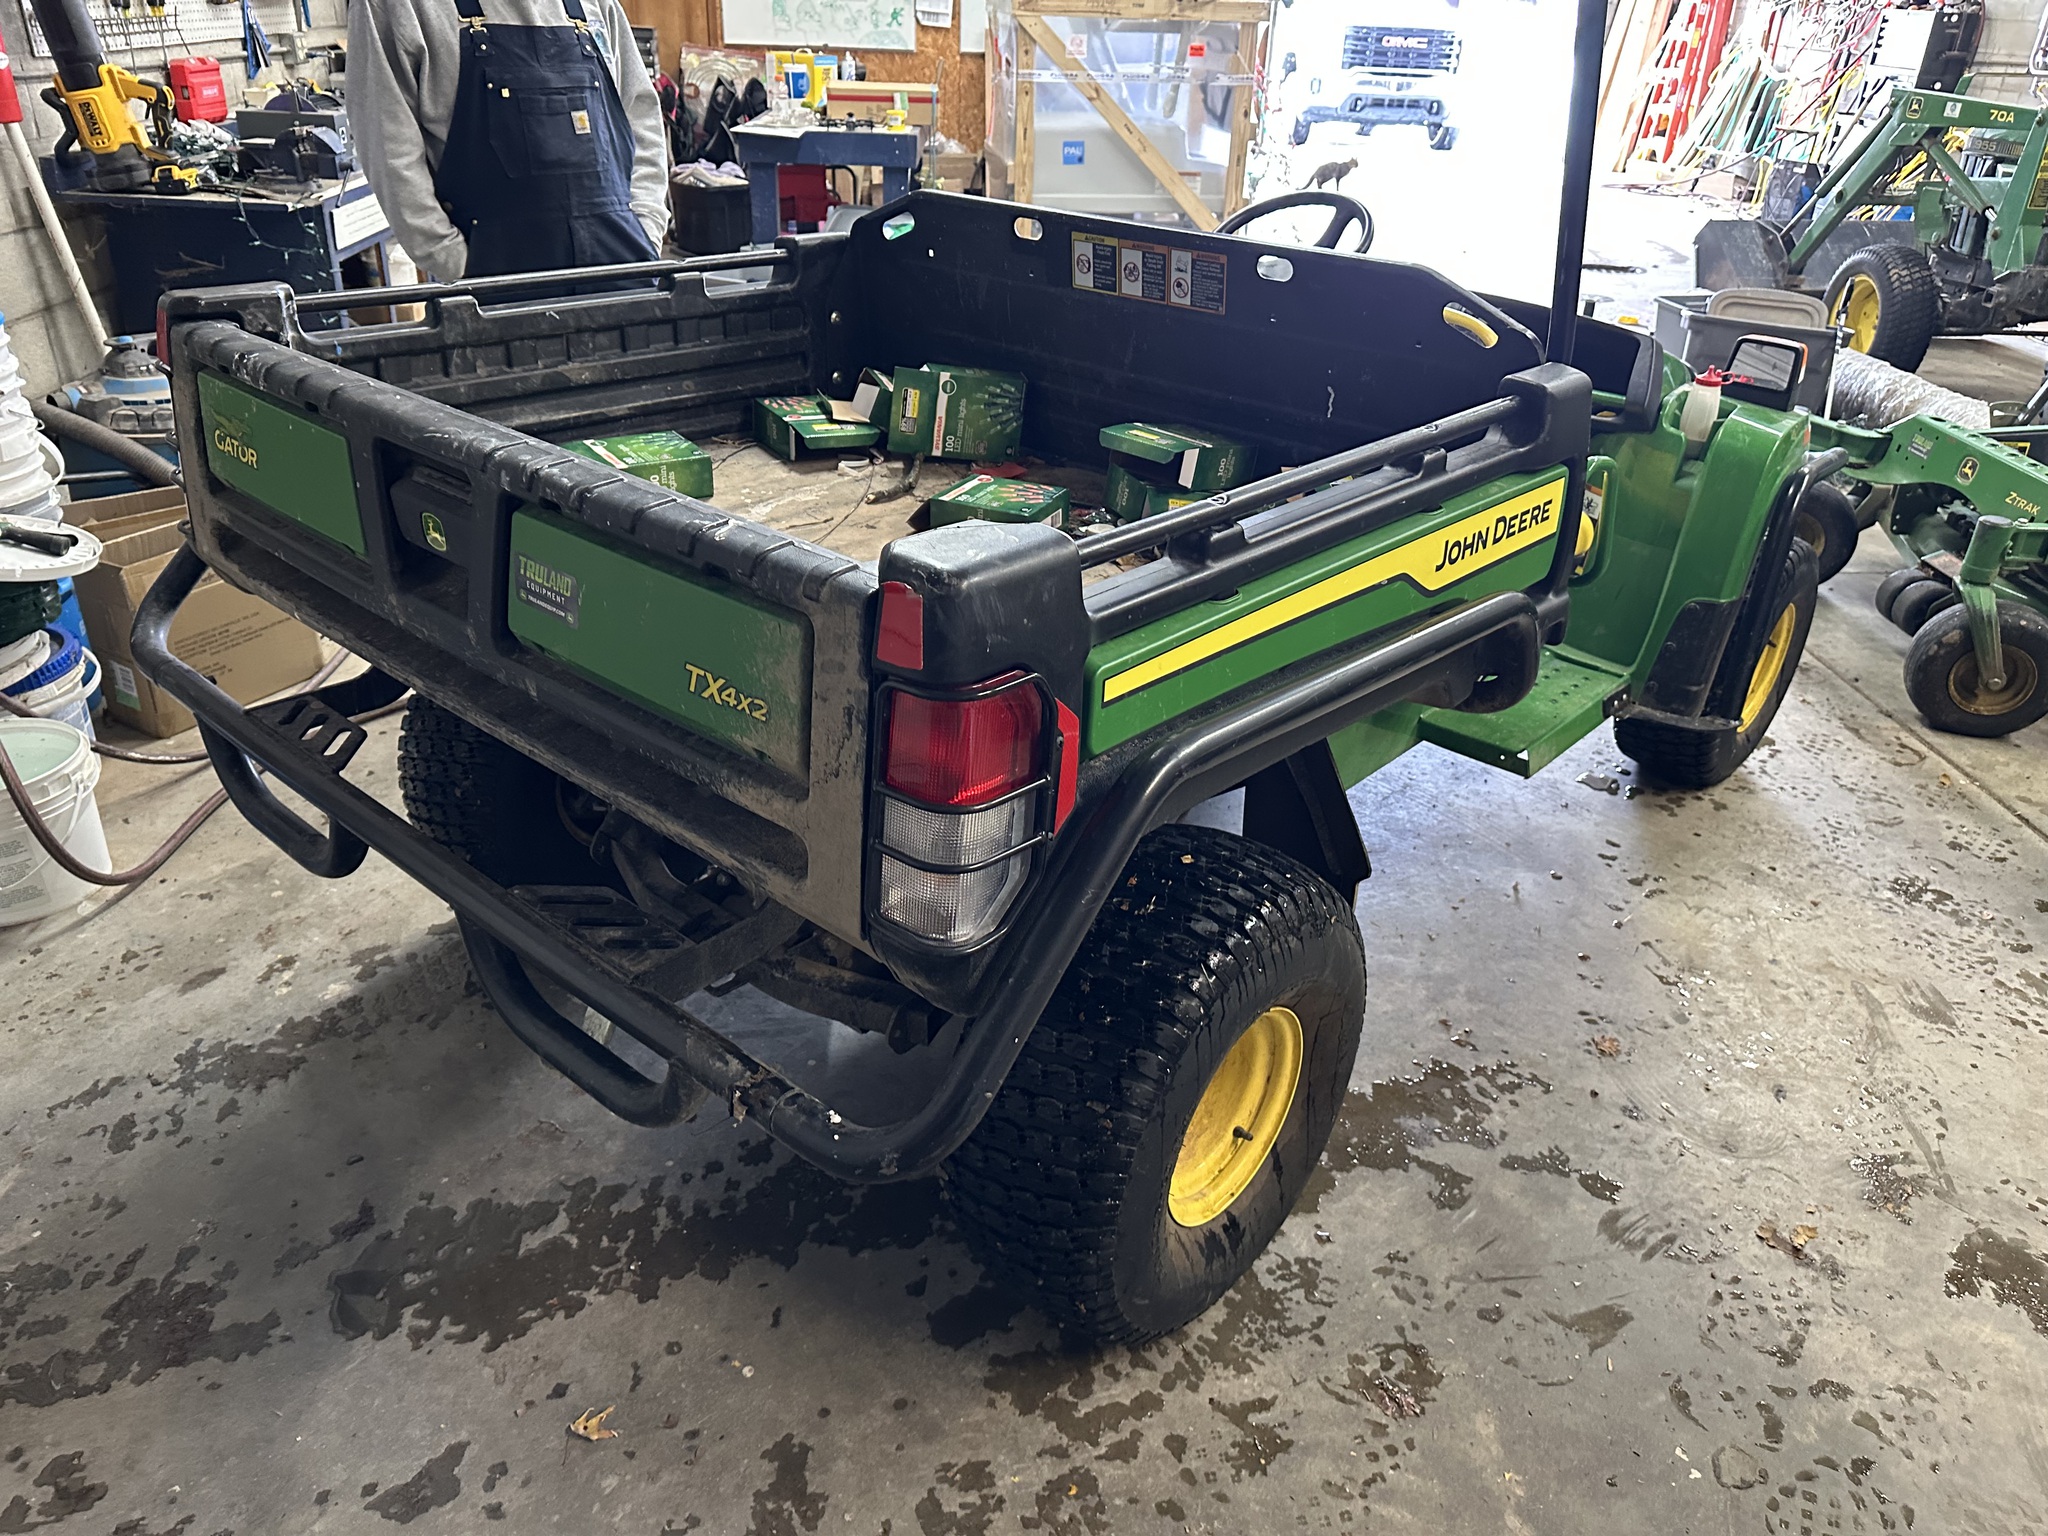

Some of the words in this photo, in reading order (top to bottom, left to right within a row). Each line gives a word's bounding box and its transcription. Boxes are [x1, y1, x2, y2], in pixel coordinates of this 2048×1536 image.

[1382, 35, 1428, 49] GMC
[1989, 109, 2015, 123] 70A
[1974, 139, 1997, 152] 955
[957, 398, 967, 418] lights
[934, 415, 943, 451] SYLVANIA
[956, 418, 964, 437] mini
[214, 428, 258, 469] GATOR
[944, 435, 955, 452] 100
[953, 437, 962, 453] LED
[2003, 491, 2042, 516] ZTRAK
[1435, 526, 1490, 573] JOHN
[1492, 498, 1553, 546] DEERE
[518, 554, 573, 598] TRULAND
[526, 580, 566, 606] EQUIPMENT
